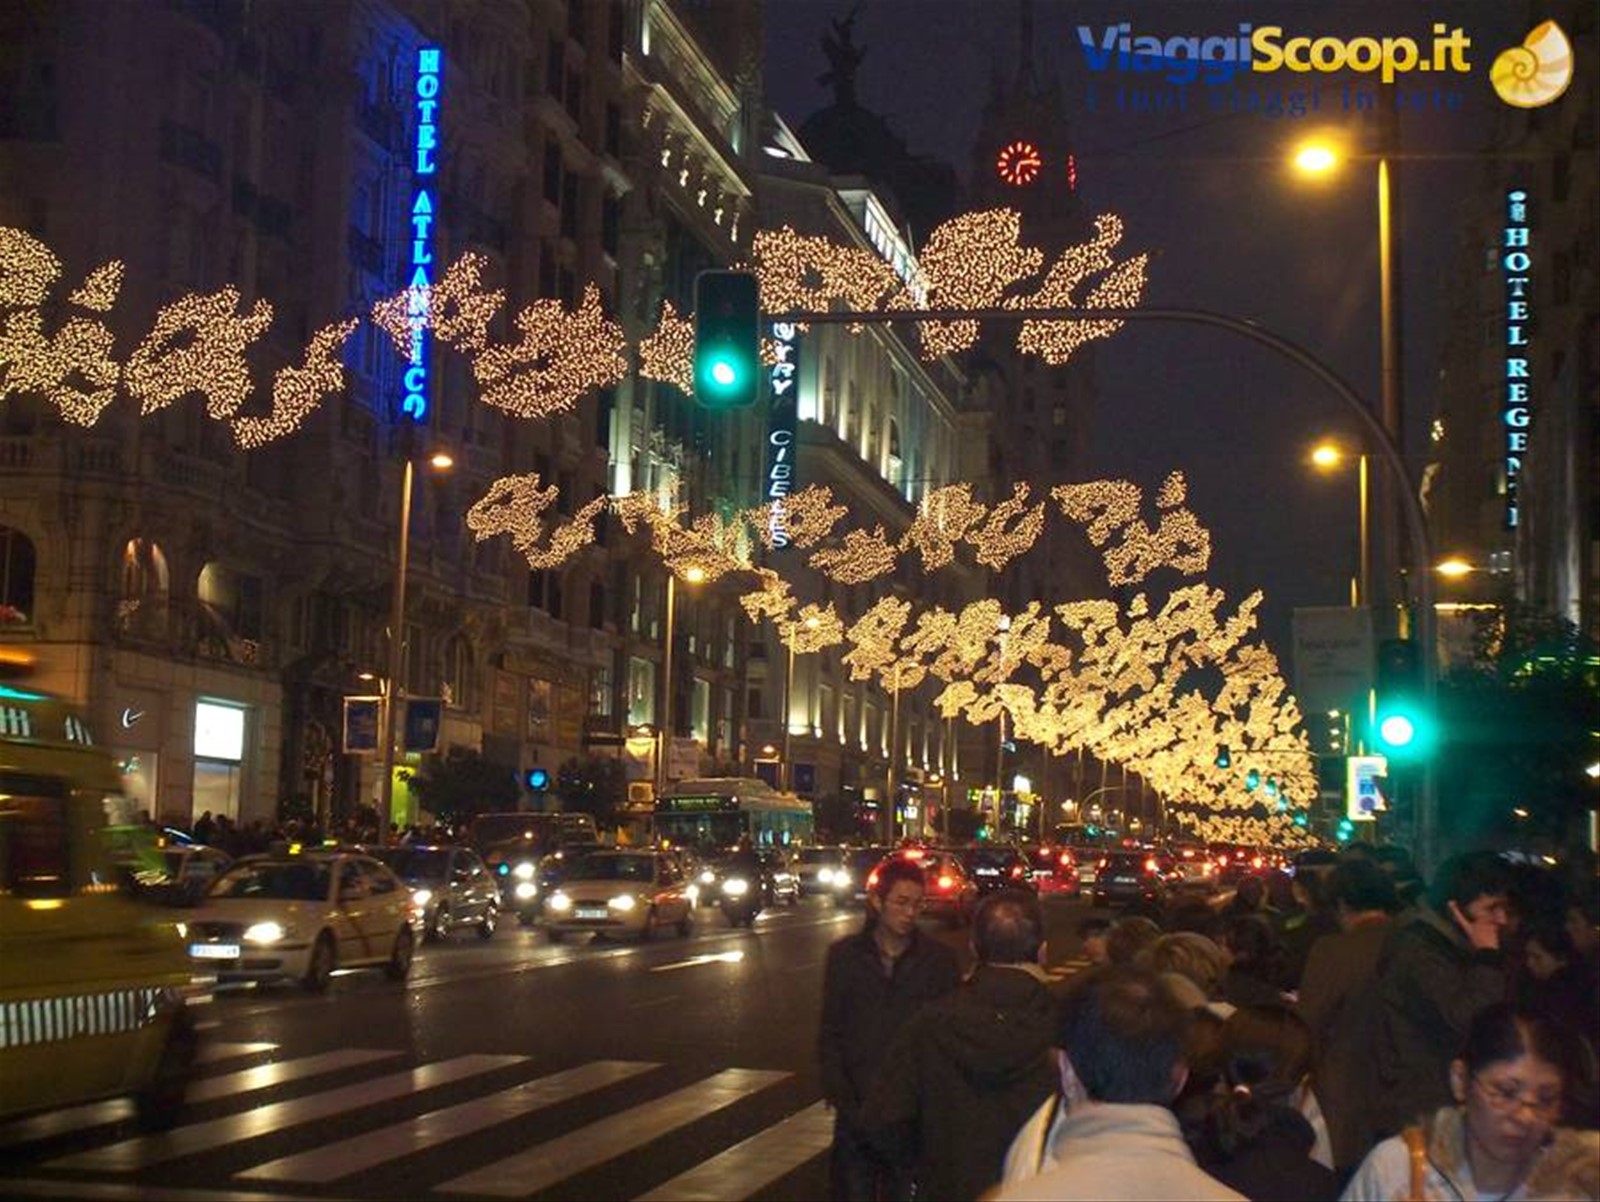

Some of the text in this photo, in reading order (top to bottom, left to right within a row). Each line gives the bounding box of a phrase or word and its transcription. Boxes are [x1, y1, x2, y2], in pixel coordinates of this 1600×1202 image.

[416, 48, 441, 174] HOTEL
[1504, 227, 1531, 346] HOTEL
[769, 430, 794, 548] CIBELES
